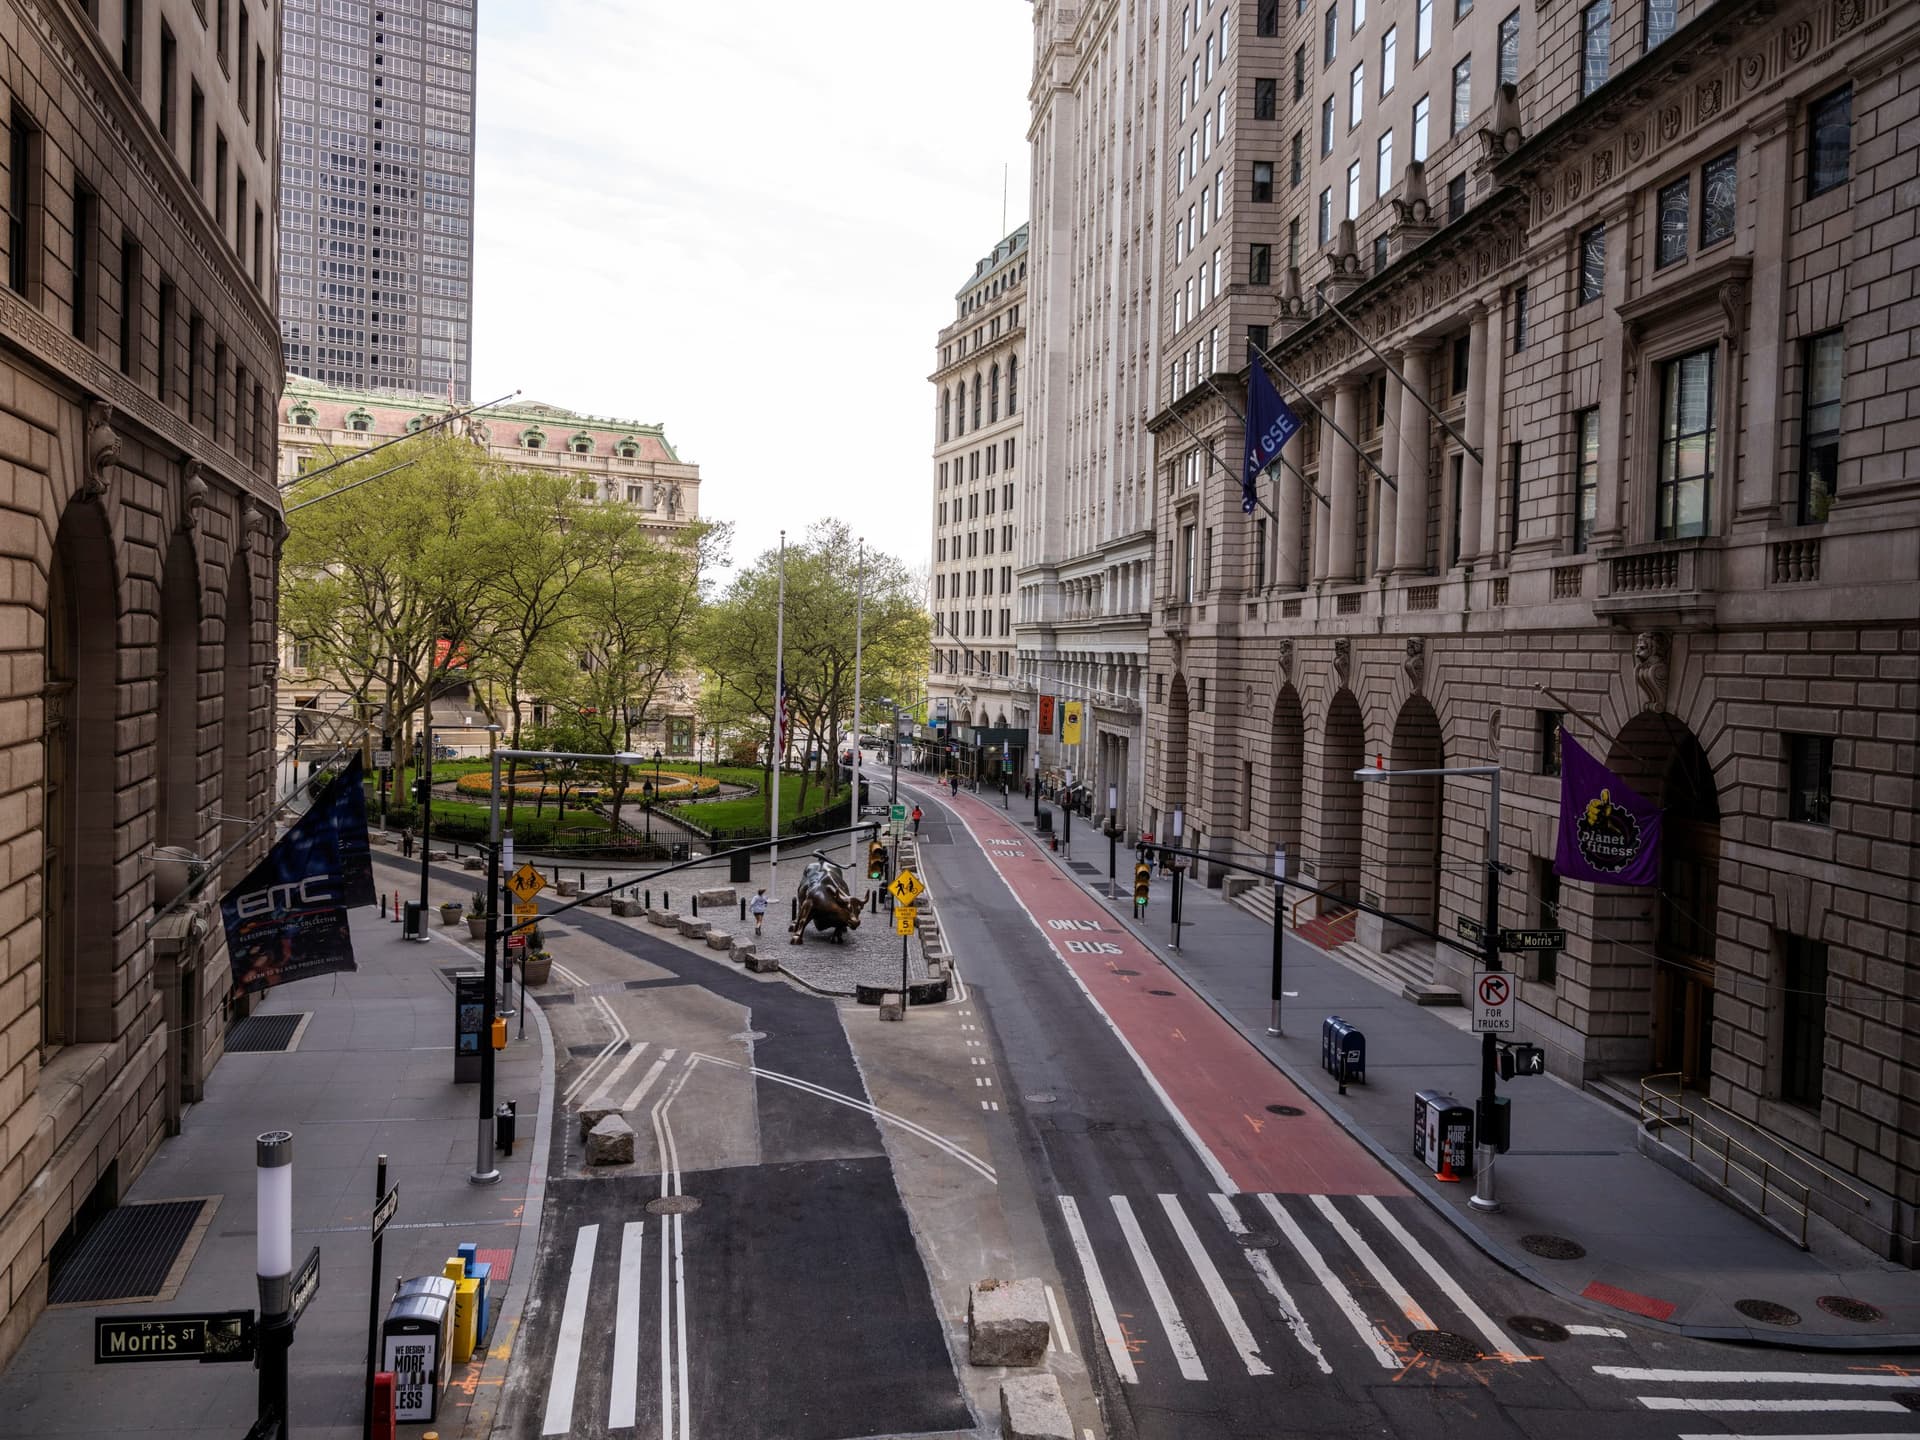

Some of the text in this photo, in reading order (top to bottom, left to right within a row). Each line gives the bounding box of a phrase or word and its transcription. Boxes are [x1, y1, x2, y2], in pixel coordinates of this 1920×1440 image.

[1261, 414, 1294, 452] GSE
[1582, 830, 1625, 845] planet
[992, 849, 1025, 857] BUS
[1586, 840, 1633, 856] fitness
[903, 920, 909, 929] 5
[1047, 919, 1103, 931] ONLY
[1524, 935, 1552, 946] Morris
[1064, 940, 1124, 955] BUS
[1485, 1008, 1502, 1017] FOR
[1478, 1019, 1510, 1029] TRUCKS
[110, 1328, 196, 1352] Morris ST
[395, 1345, 405, 1355] WE
[405, 1345, 425, 1354] DESIGN
[395, 1355, 425, 1373] MORE
